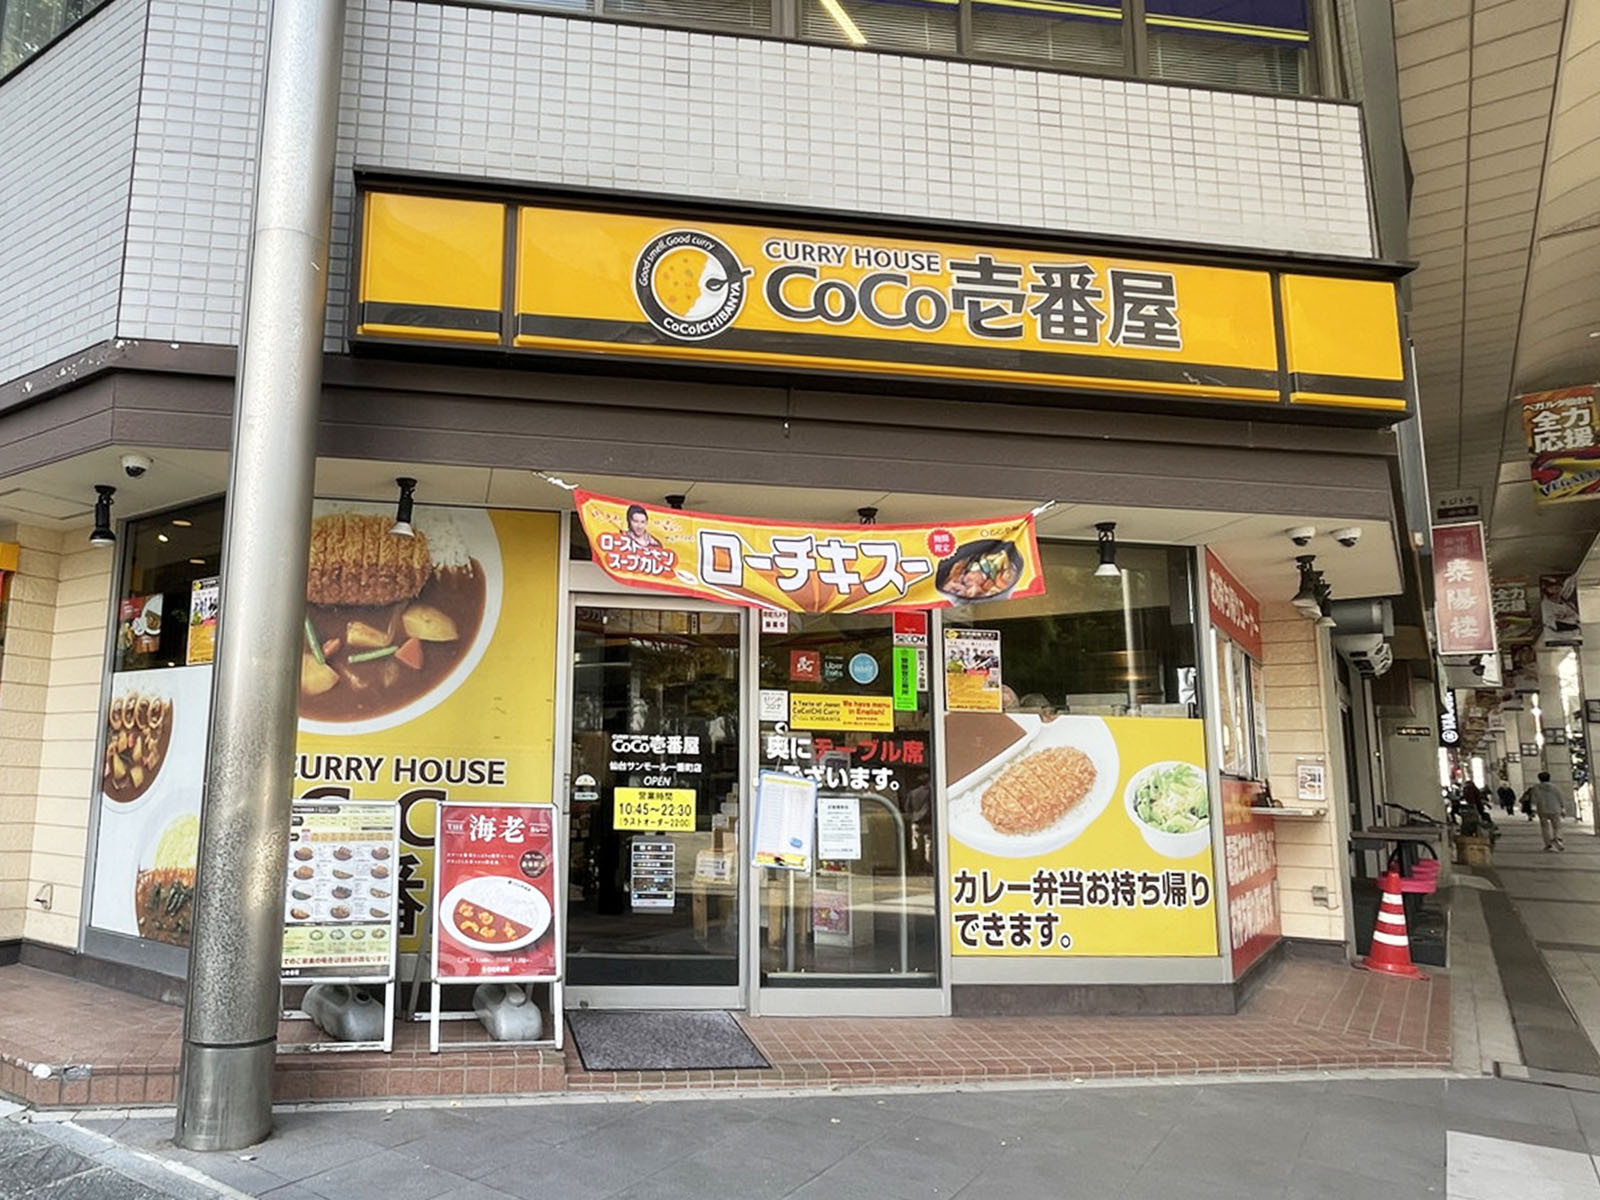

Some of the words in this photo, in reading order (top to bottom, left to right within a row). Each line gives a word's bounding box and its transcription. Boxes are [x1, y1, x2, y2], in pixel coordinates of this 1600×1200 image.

[765, 241, 846, 264] CURRY
[855, 248, 940, 272] HOUSE
[766, 255, 1181, 349] CoCo壱番屋
[1532, 407, 1591, 433] 全力
[1534, 426, 1596, 453] 応援
[701, 531, 930, 595] ローチキスー
[766, 736, 924, 764] 奥にテーブル席
[295, 755, 384, 783] URRY
[394, 758, 506, 786] HOUSE
[643, 775, 672, 786] OPEN
[469, 813, 526, 843] 海老
[953, 869, 1211, 907] カレー弁当お持ち帰り
[953, 911, 1072, 949] できます。
